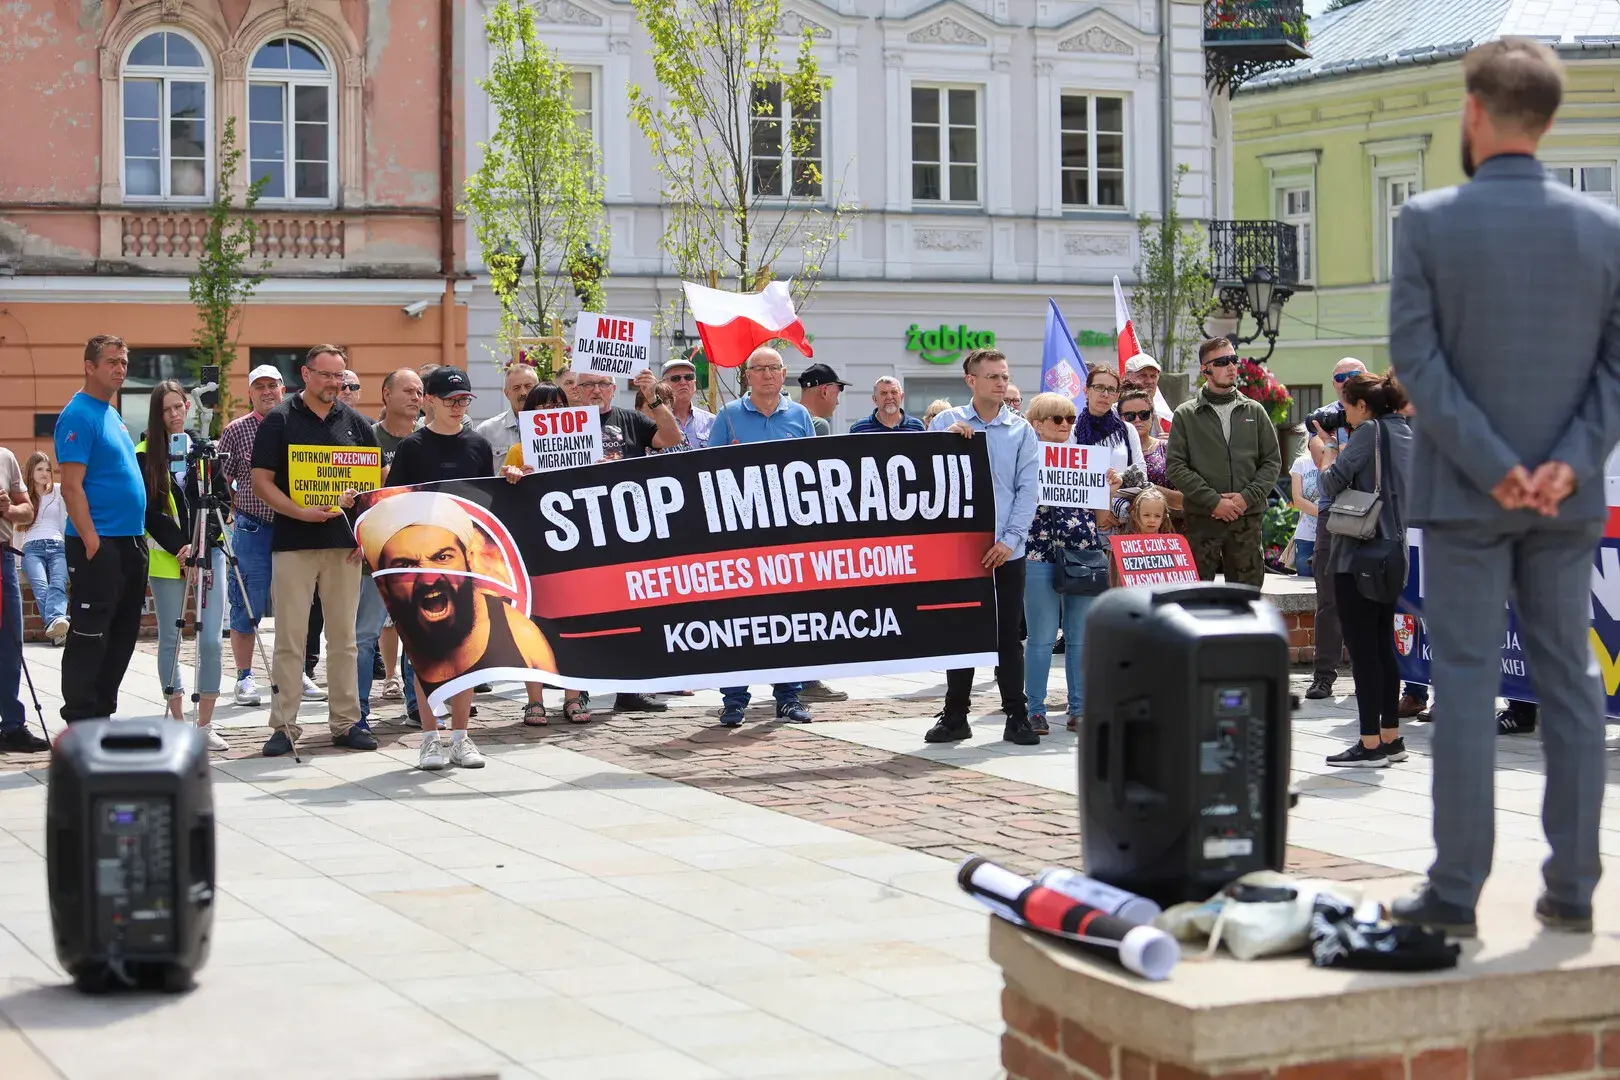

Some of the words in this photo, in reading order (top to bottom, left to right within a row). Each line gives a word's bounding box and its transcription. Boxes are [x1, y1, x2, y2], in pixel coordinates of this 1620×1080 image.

[596, 318, 635, 343] NIE!
[905, 323, 996, 351] żabka
[578, 338, 595, 354] DLA
[596, 341, 647, 361] NIELEGALNEJ
[590, 356, 633, 375] MIGRACJI!
[533, 410, 588, 436] STOP
[532, 435, 594, 454] NIELEGALNYM
[292, 450, 331, 463] PIOTRKÓW
[333, 452, 378, 465] PRZECIWKO
[538, 451, 592, 469] MIGRANTOM
[1045, 446, 1088, 469] NIE!
[317, 466, 352, 478] BUDOWIE
[1046, 470, 1105, 488] NIELEGALNEJ
[294, 479, 330, 492] CENTRUM
[1042, 486, 1089, 504] MIGRACJI!
[540, 475, 685, 552] STOP
[699, 454, 975, 534] IMIGRACJI!
[1120, 539, 1145, 555] CHCĘ
[1145, 537, 1167, 552] CZUĆ
[1167, 538, 1182, 553] SIĘ
[1122, 555, 1175, 571] BEZPIECZNA
[1175, 554, 1189, 567] WE
[625, 557, 751, 601] REFUGEES
[758, 552, 805, 588] NOT
[810, 544, 917, 581] WELCOME
[663, 607, 902, 653] KONFEDERACJA
